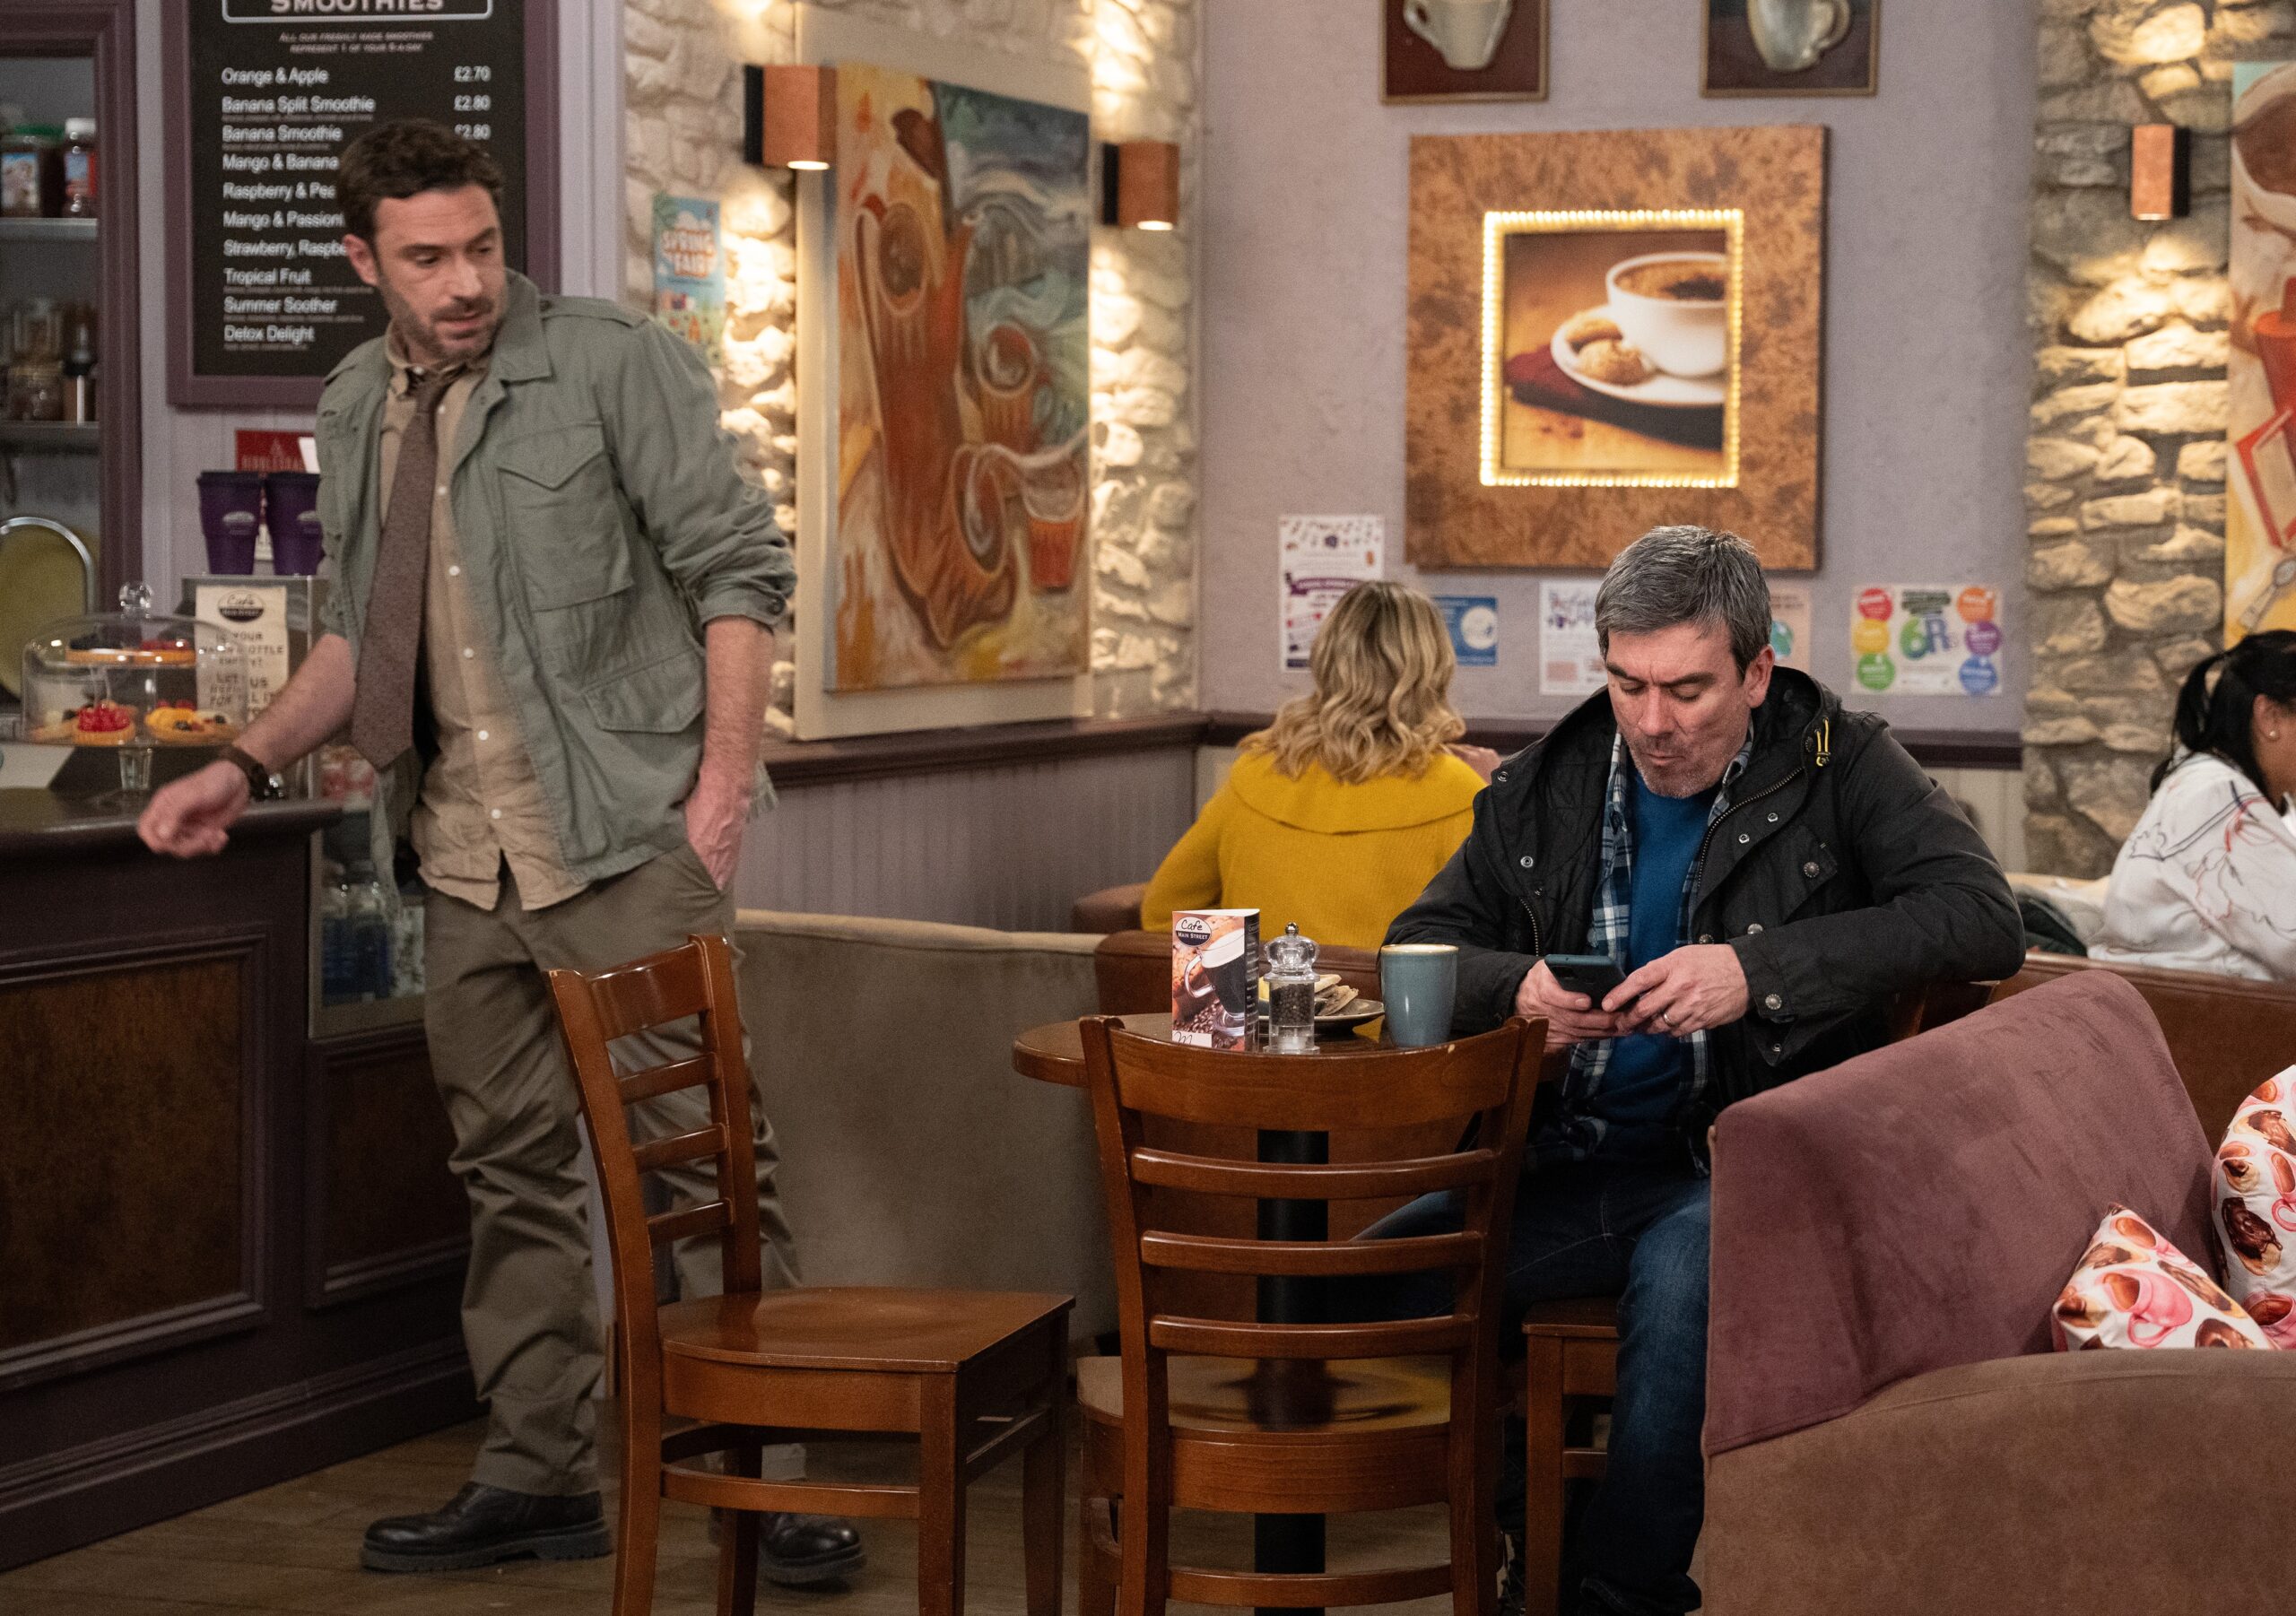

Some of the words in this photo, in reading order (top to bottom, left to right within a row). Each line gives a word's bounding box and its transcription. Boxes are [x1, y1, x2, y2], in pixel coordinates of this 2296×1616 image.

[270, 0, 444, 13] SMOOTHIES
[222, 66, 274, 88] Orange
[275, 66, 288, 85] &
[288, 66, 330, 88] Apple
[454, 65, 491, 83] £2.70
[222, 95, 276, 113] Banana
[277, 95, 309, 115] Split
[310, 94, 376, 113] Smoothie
[454, 94, 491, 111] £2.80
[222, 124, 276, 143] Banana
[278, 124, 344, 143] Smoothie
[222, 153, 271, 175] Mango
[272, 153, 284, 171] &
[286, 152, 340, 171] Banana
[222, 182, 294, 203] Raspberry
[295, 182, 309, 199] &
[223, 211, 271, 230] Mango
[273, 211, 285, 228] &
[223, 239, 298, 259] Strawberry,
[223, 267, 279, 288] Tropical
[280, 267, 312, 285] Fruit
[224, 295, 282, 314] Summer
[283, 295, 338, 314] Soother
[224, 324, 265, 343] Detox
[266, 324, 315, 345] Delight
[1180, 919, 1203, 931] Cafe
